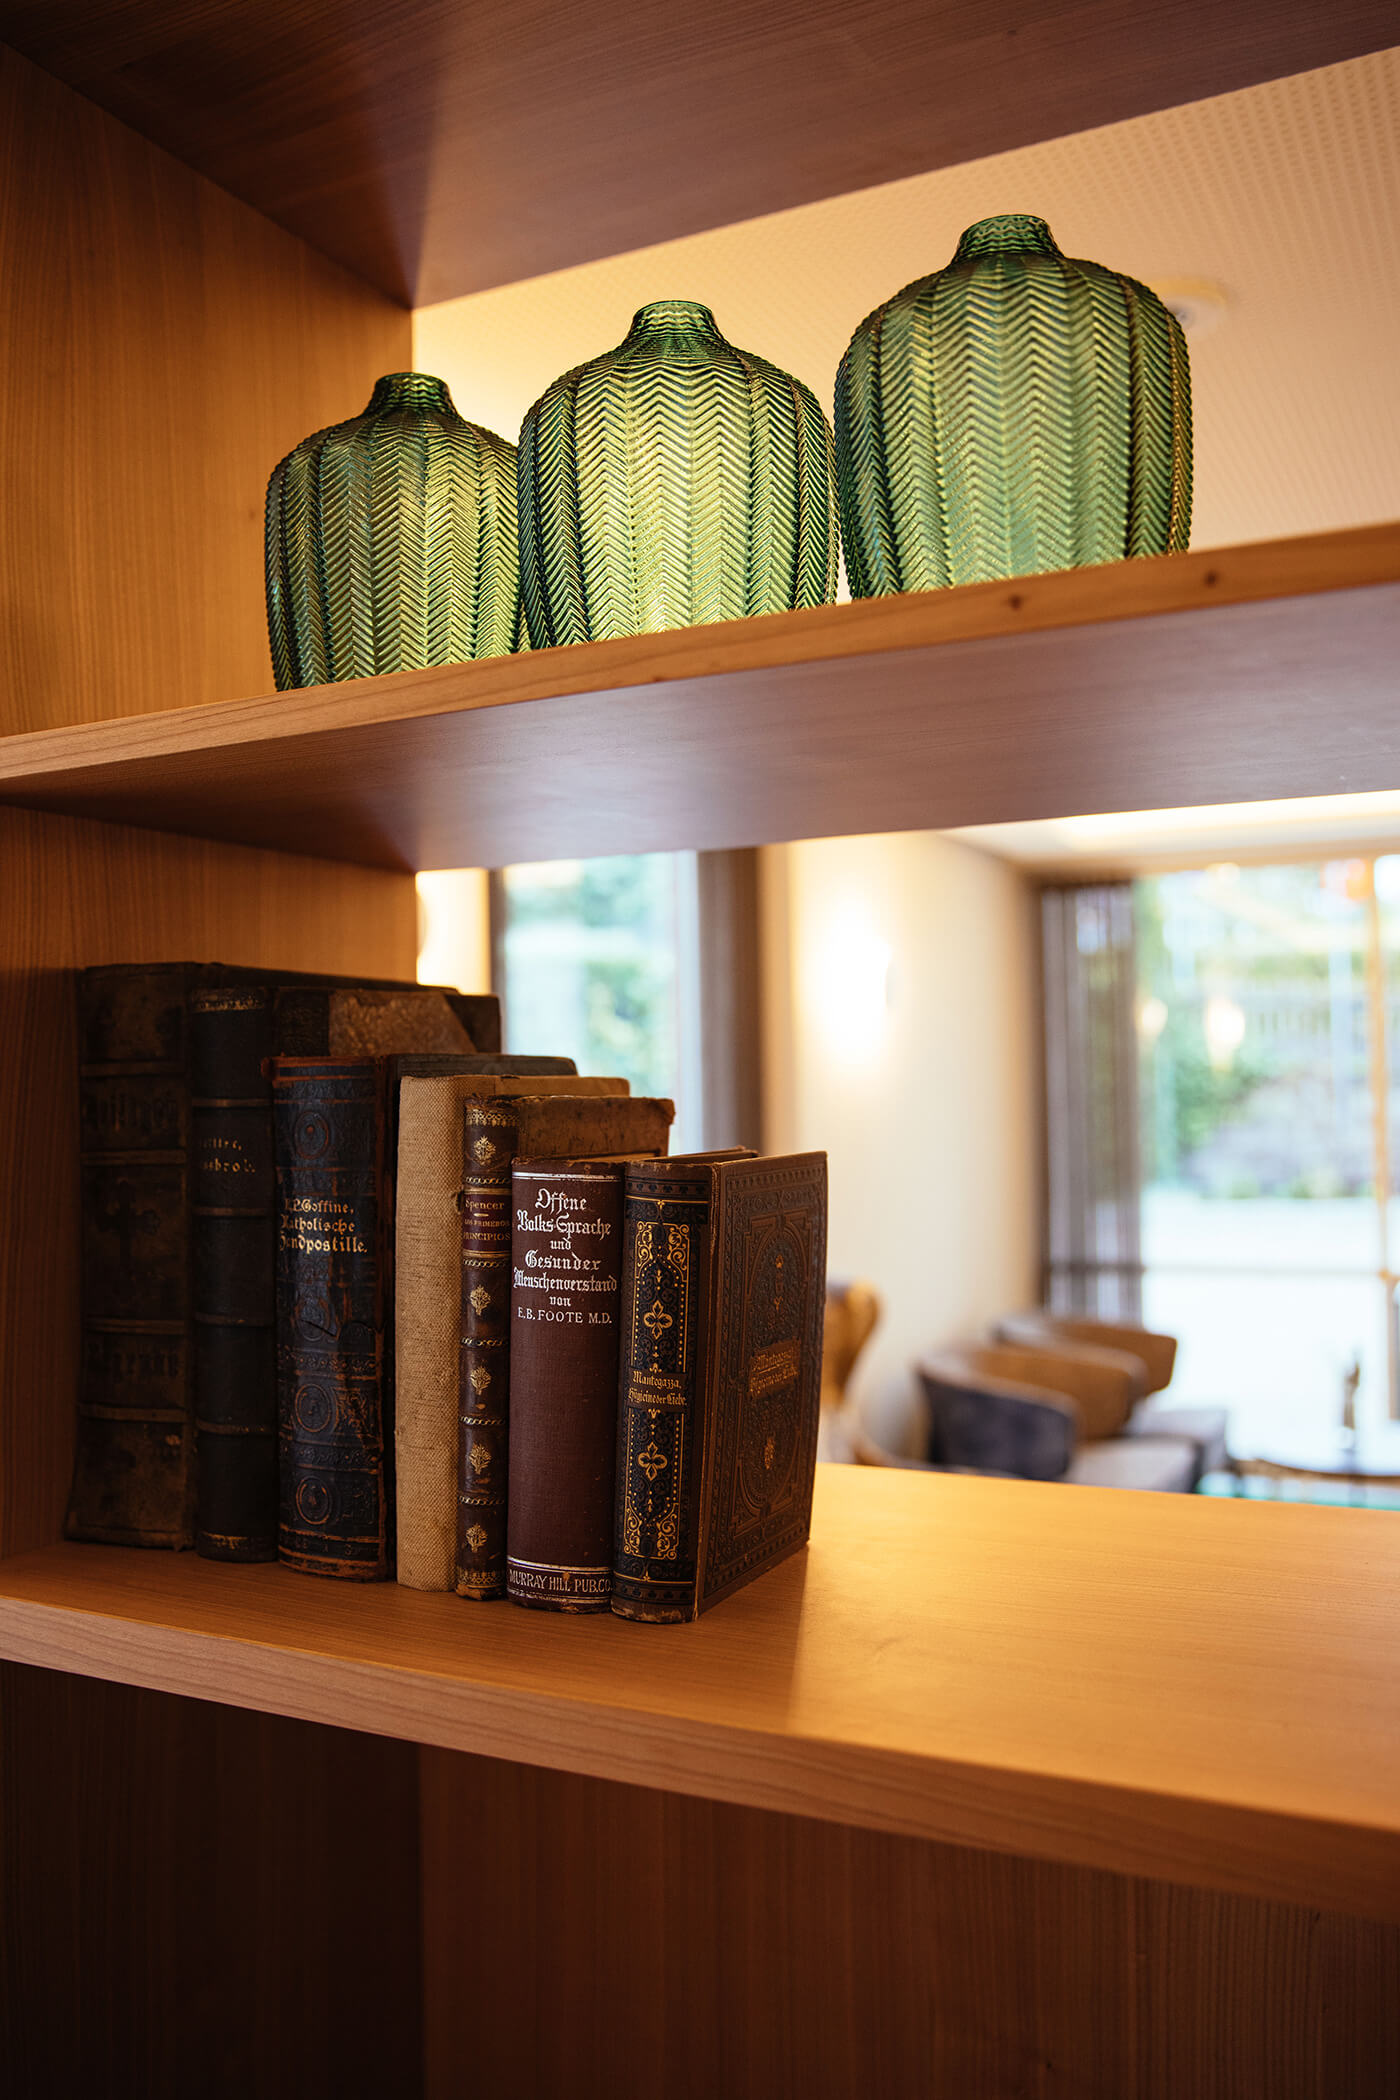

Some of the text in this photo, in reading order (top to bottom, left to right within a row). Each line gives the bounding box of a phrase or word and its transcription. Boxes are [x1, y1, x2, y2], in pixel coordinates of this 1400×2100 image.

[465, 1199, 505, 1212] Spencer
[534, 1187, 588, 1216] Offene
[550, 1237, 572, 1250] und
[525, 1249, 602, 1271] Gesunder
[513, 1266, 618, 1292] Menschenverstand
[549, 1296, 572, 1307] von
[537, 1309, 584, 1323] FOOTE
[588, 1312, 613, 1324] M.D.
[508, 1568, 547, 1590] MURRAY
[549, 1576, 571, 1592] HILL
